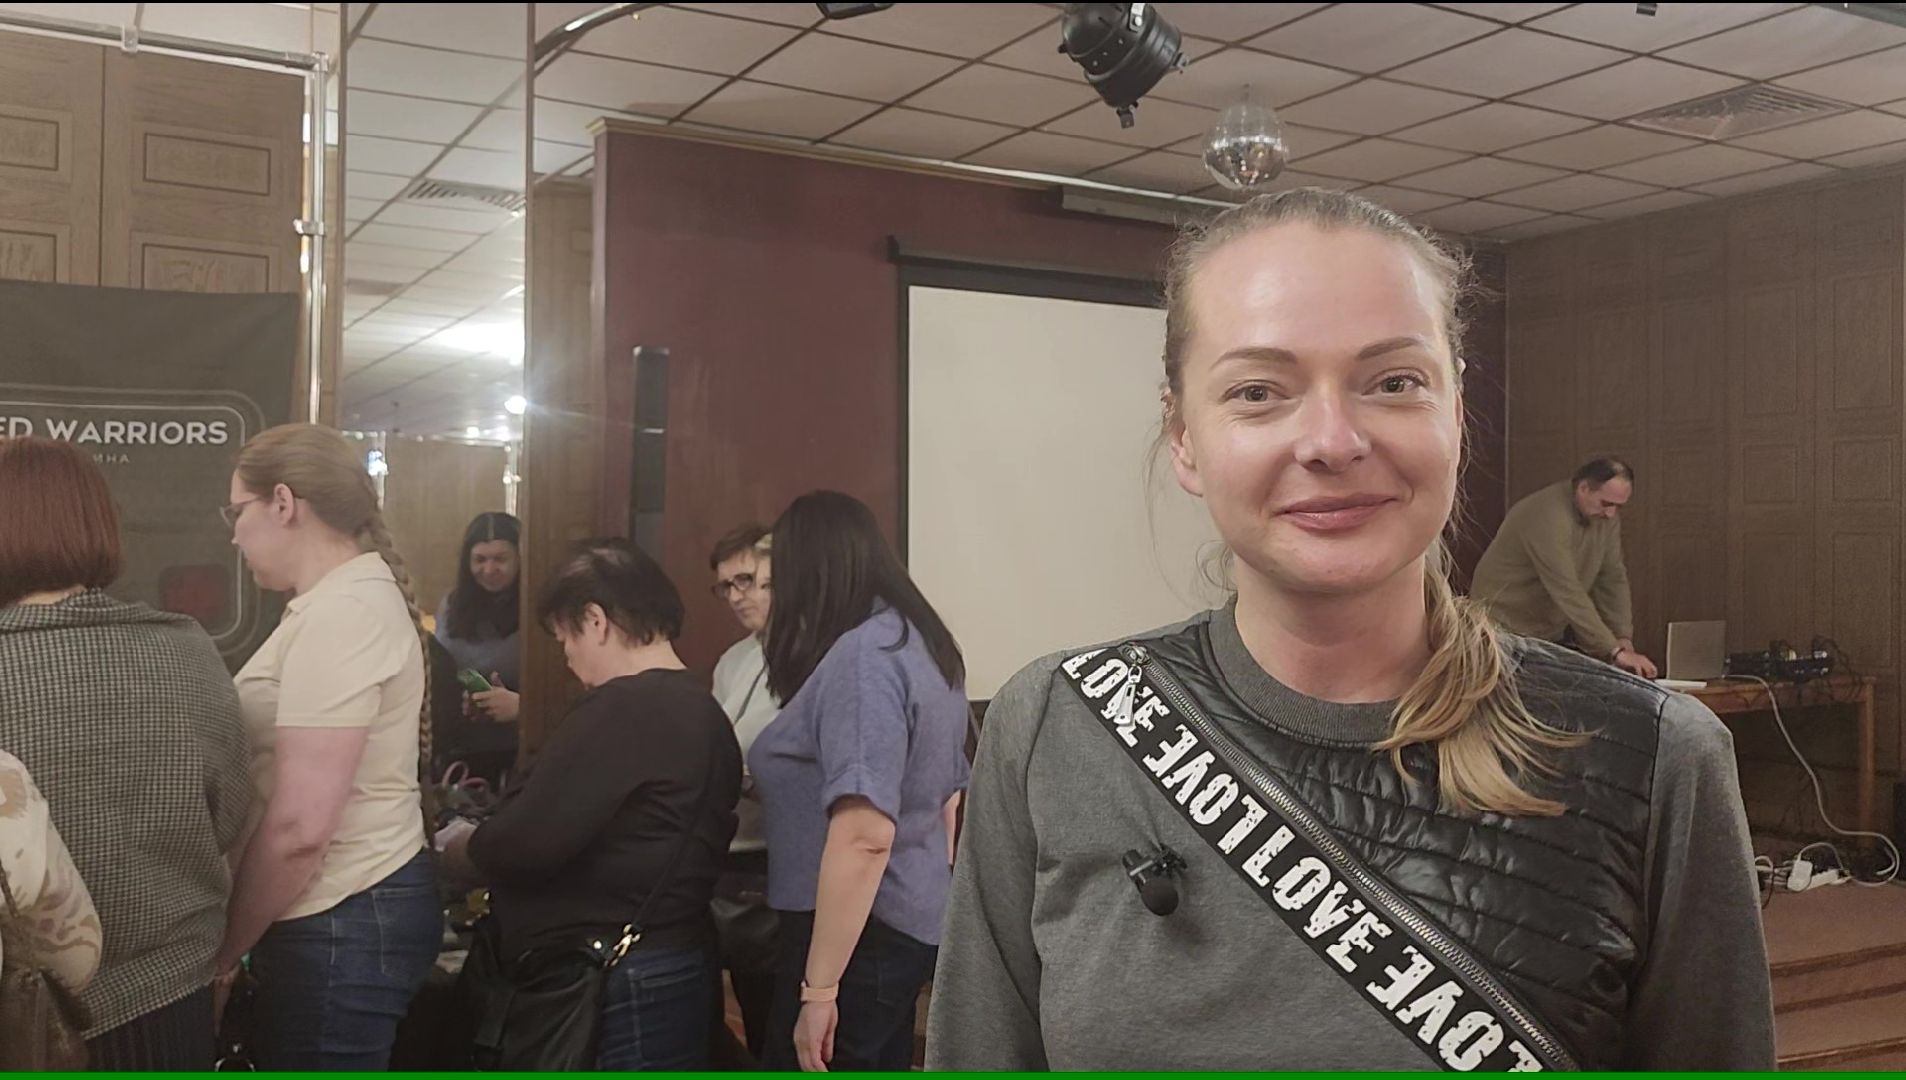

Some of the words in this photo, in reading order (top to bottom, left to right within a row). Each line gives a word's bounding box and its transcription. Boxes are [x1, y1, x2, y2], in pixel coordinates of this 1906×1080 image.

[46, 418, 228, 444] WARRIORS
[1142, 724, 1268, 854] LOVE
[1241, 825, 1393, 972] LOVE
